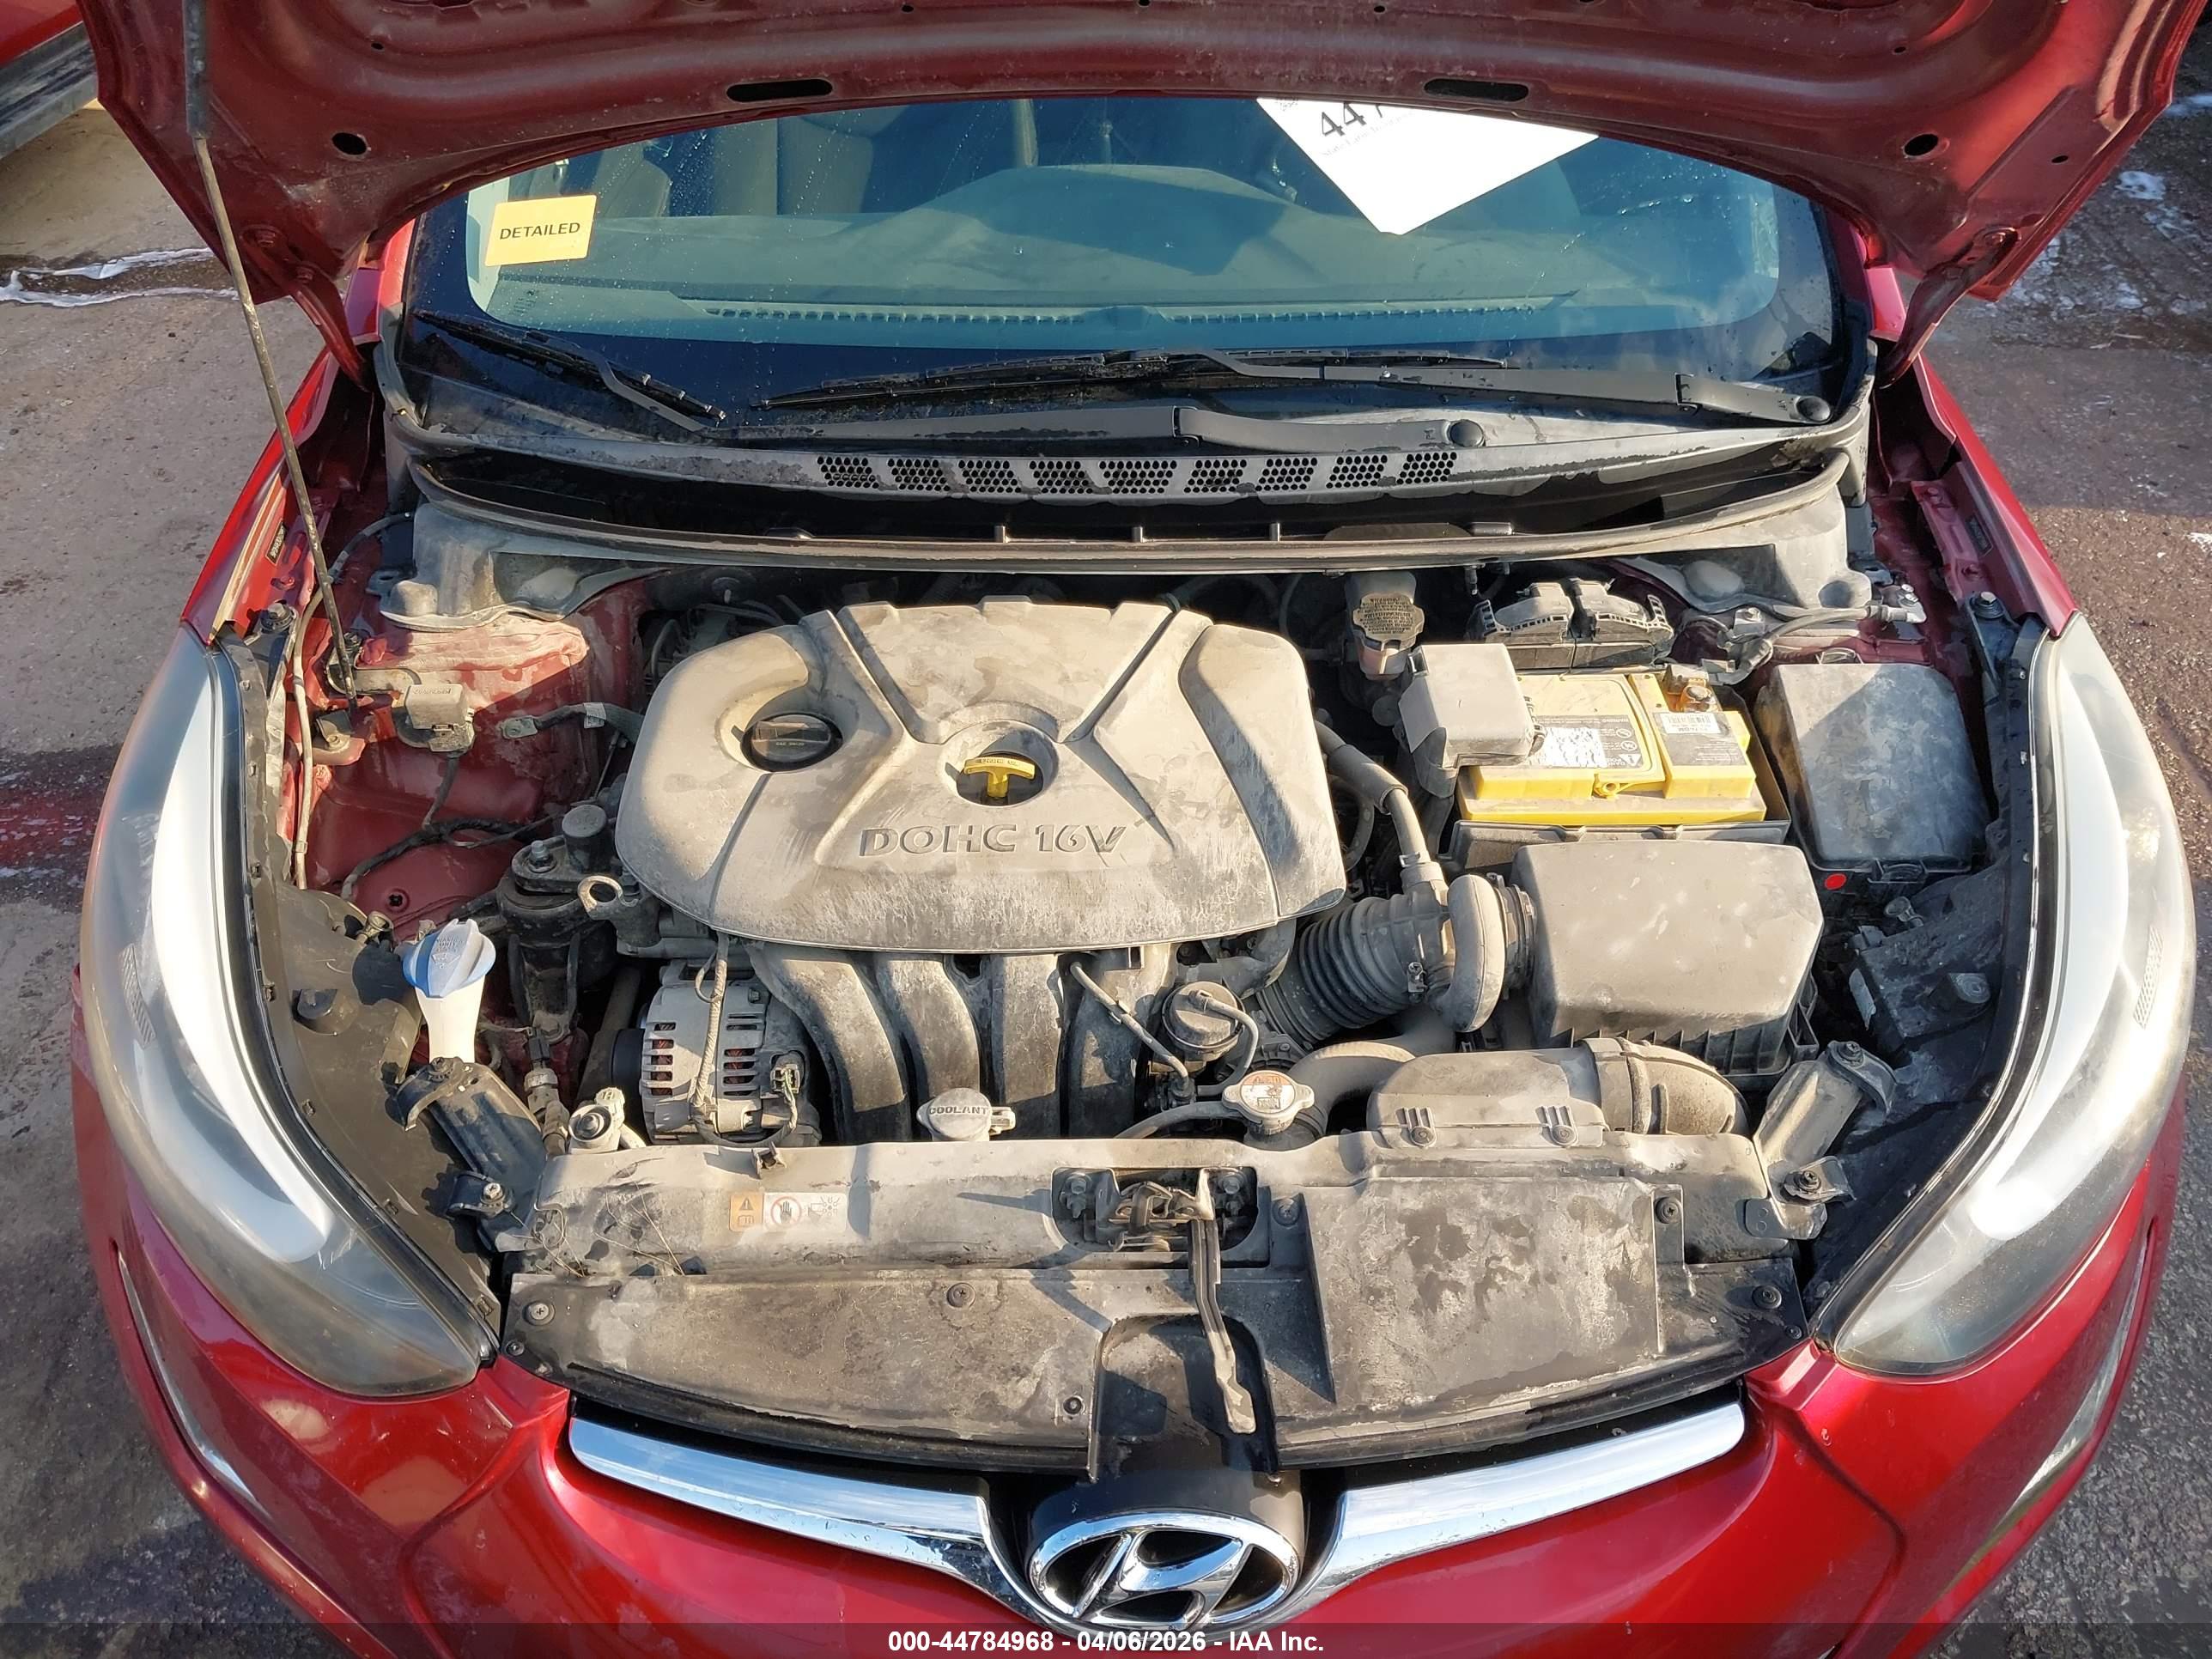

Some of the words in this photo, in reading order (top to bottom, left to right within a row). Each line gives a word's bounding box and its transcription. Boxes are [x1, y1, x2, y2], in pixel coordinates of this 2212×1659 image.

[500, 222, 580, 240] DETAILED
[859, 823, 1017, 857] DOHC
[1035, 824, 1127, 854] 16V
[929, 1106, 989, 1115] COOLANT
